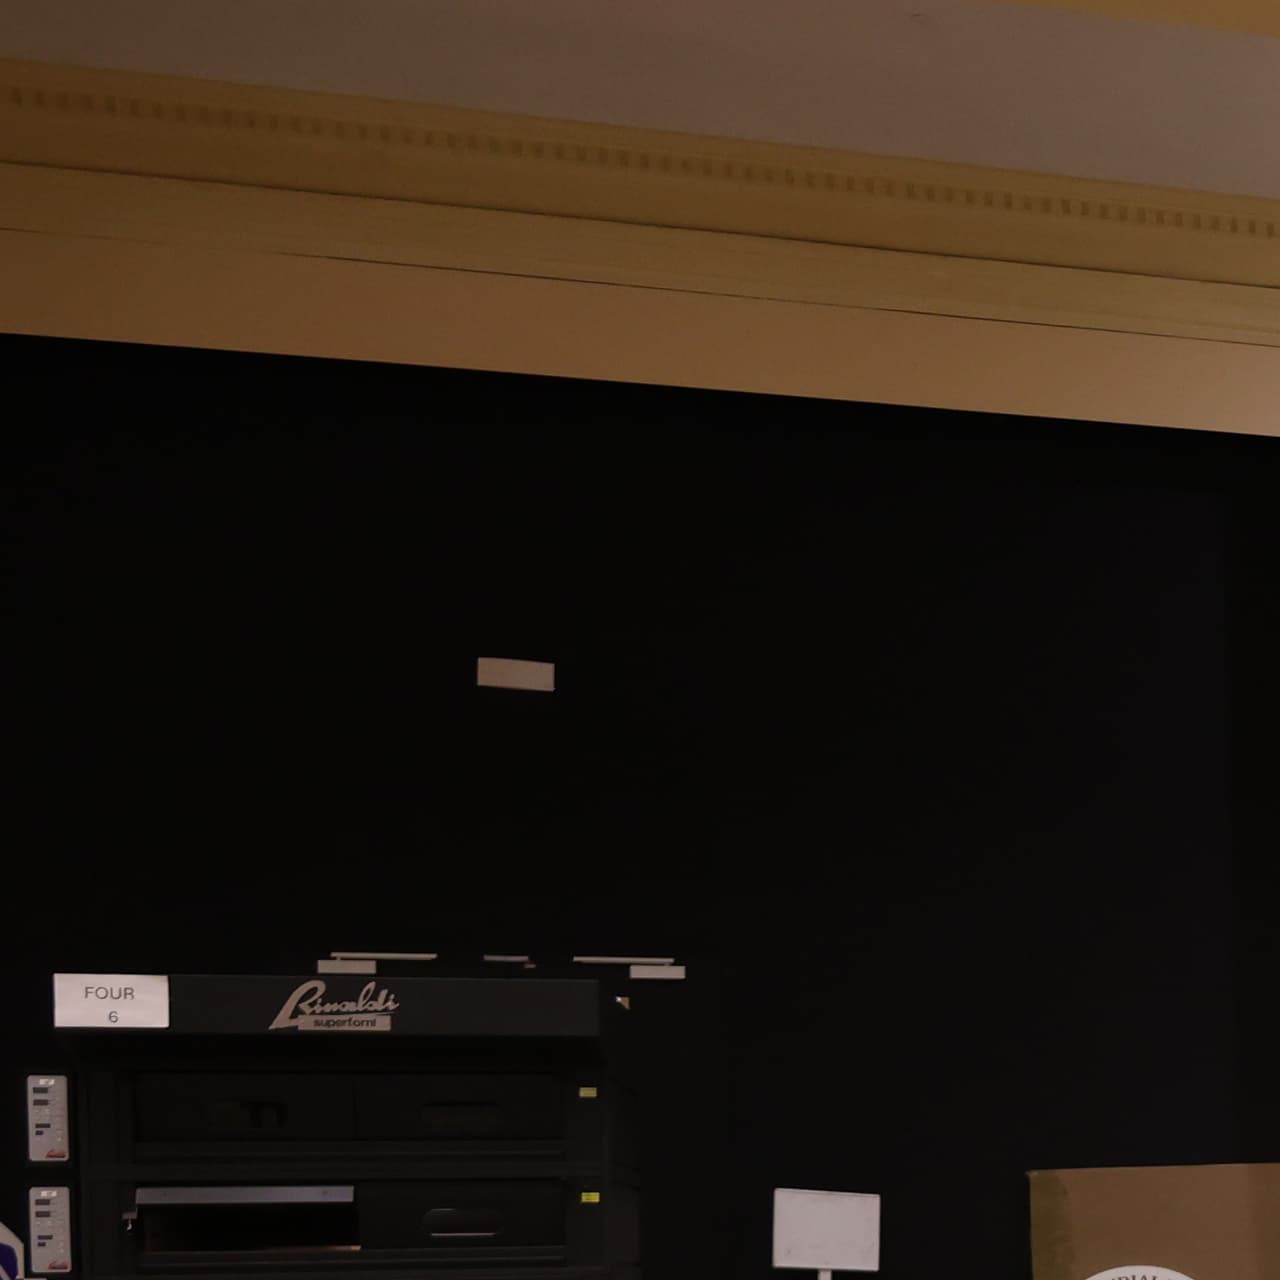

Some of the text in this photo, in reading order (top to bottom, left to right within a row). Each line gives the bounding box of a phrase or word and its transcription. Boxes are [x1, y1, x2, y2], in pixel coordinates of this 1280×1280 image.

[84, 986, 135, 1001] FOUR
[268, 979, 400, 1031] Rinaldi
[108, 1011, 118, 1024] 6
[313, 1017, 377, 1029] superforni
